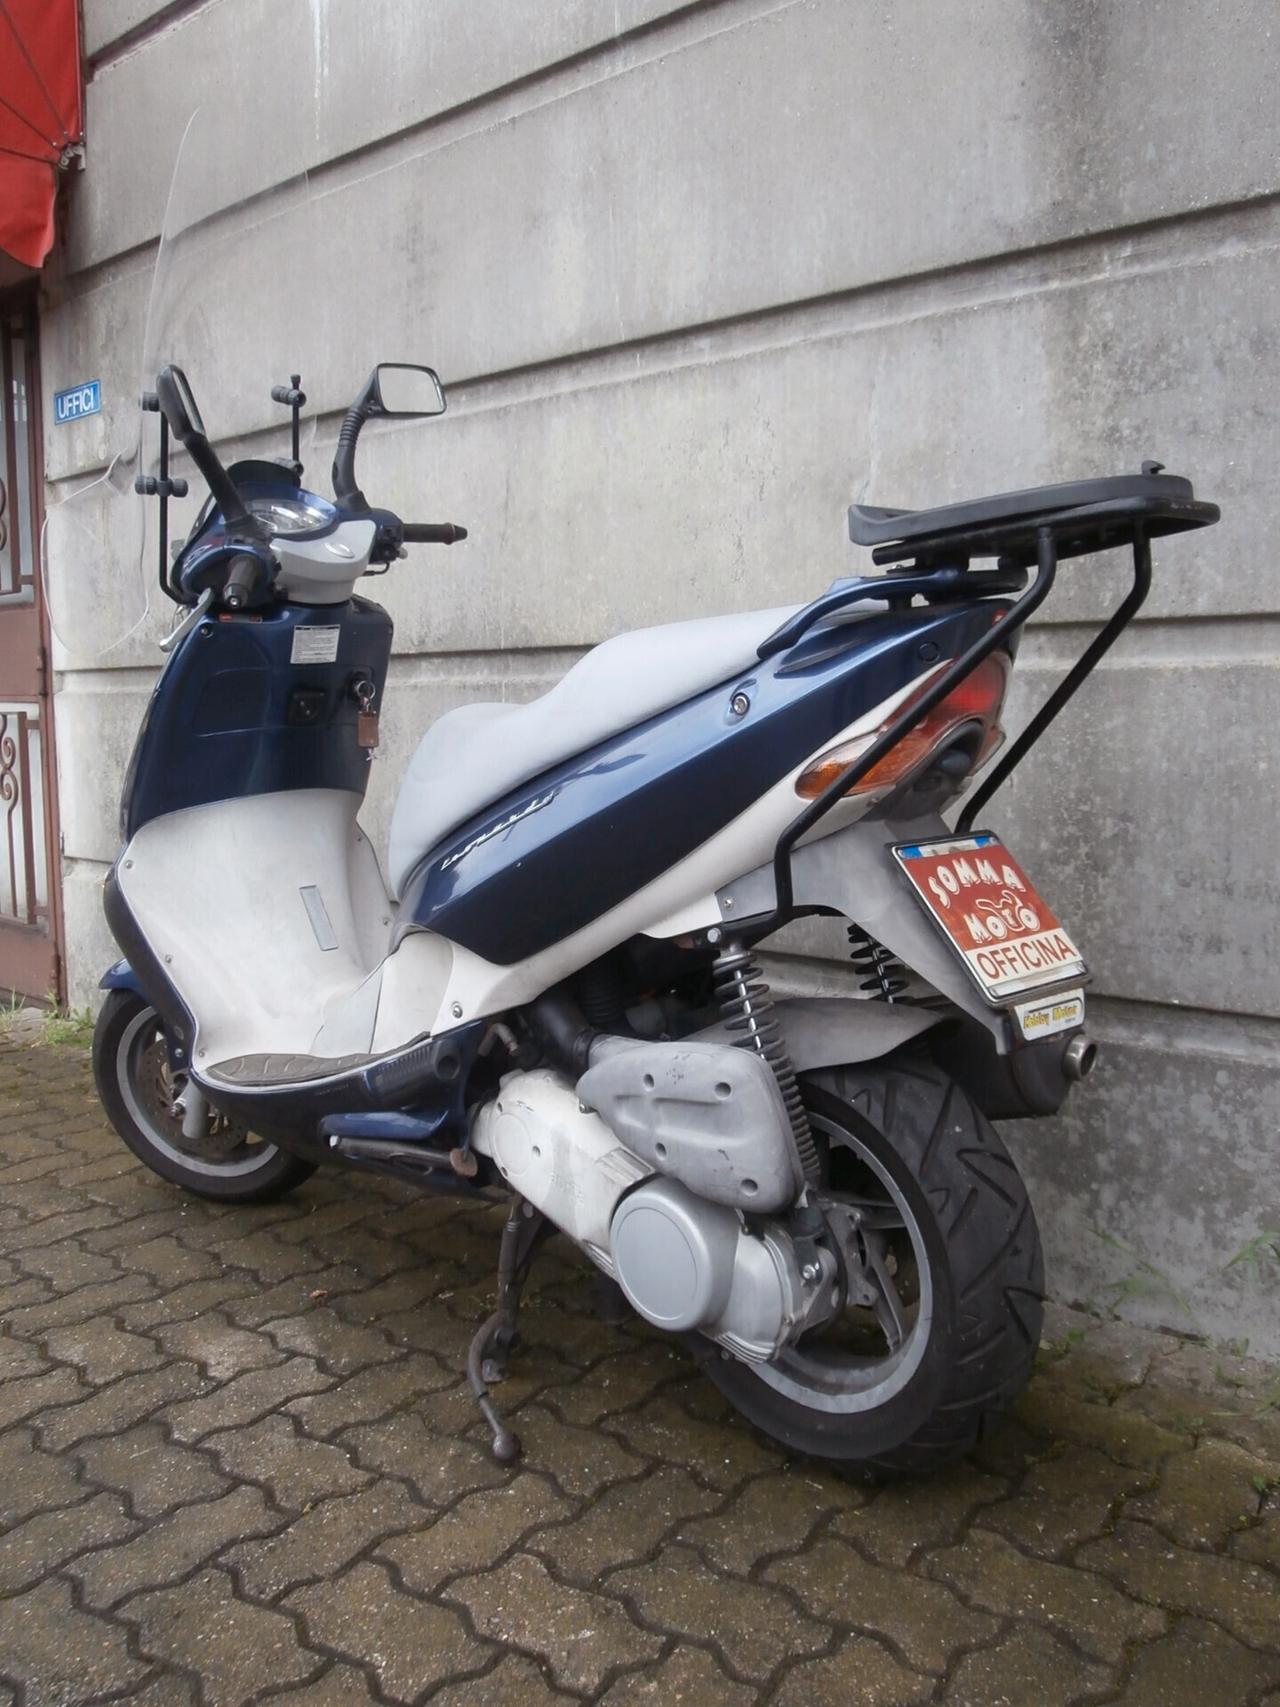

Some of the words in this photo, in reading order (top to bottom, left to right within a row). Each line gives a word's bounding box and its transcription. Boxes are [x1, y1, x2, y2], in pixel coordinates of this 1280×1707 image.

[58, 386, 94, 418] UFFICI
[928, 857, 1026, 909] SOMMA
[963, 907, 1040, 944] MOTO
[976, 934, 1076, 979] OFFICINA
